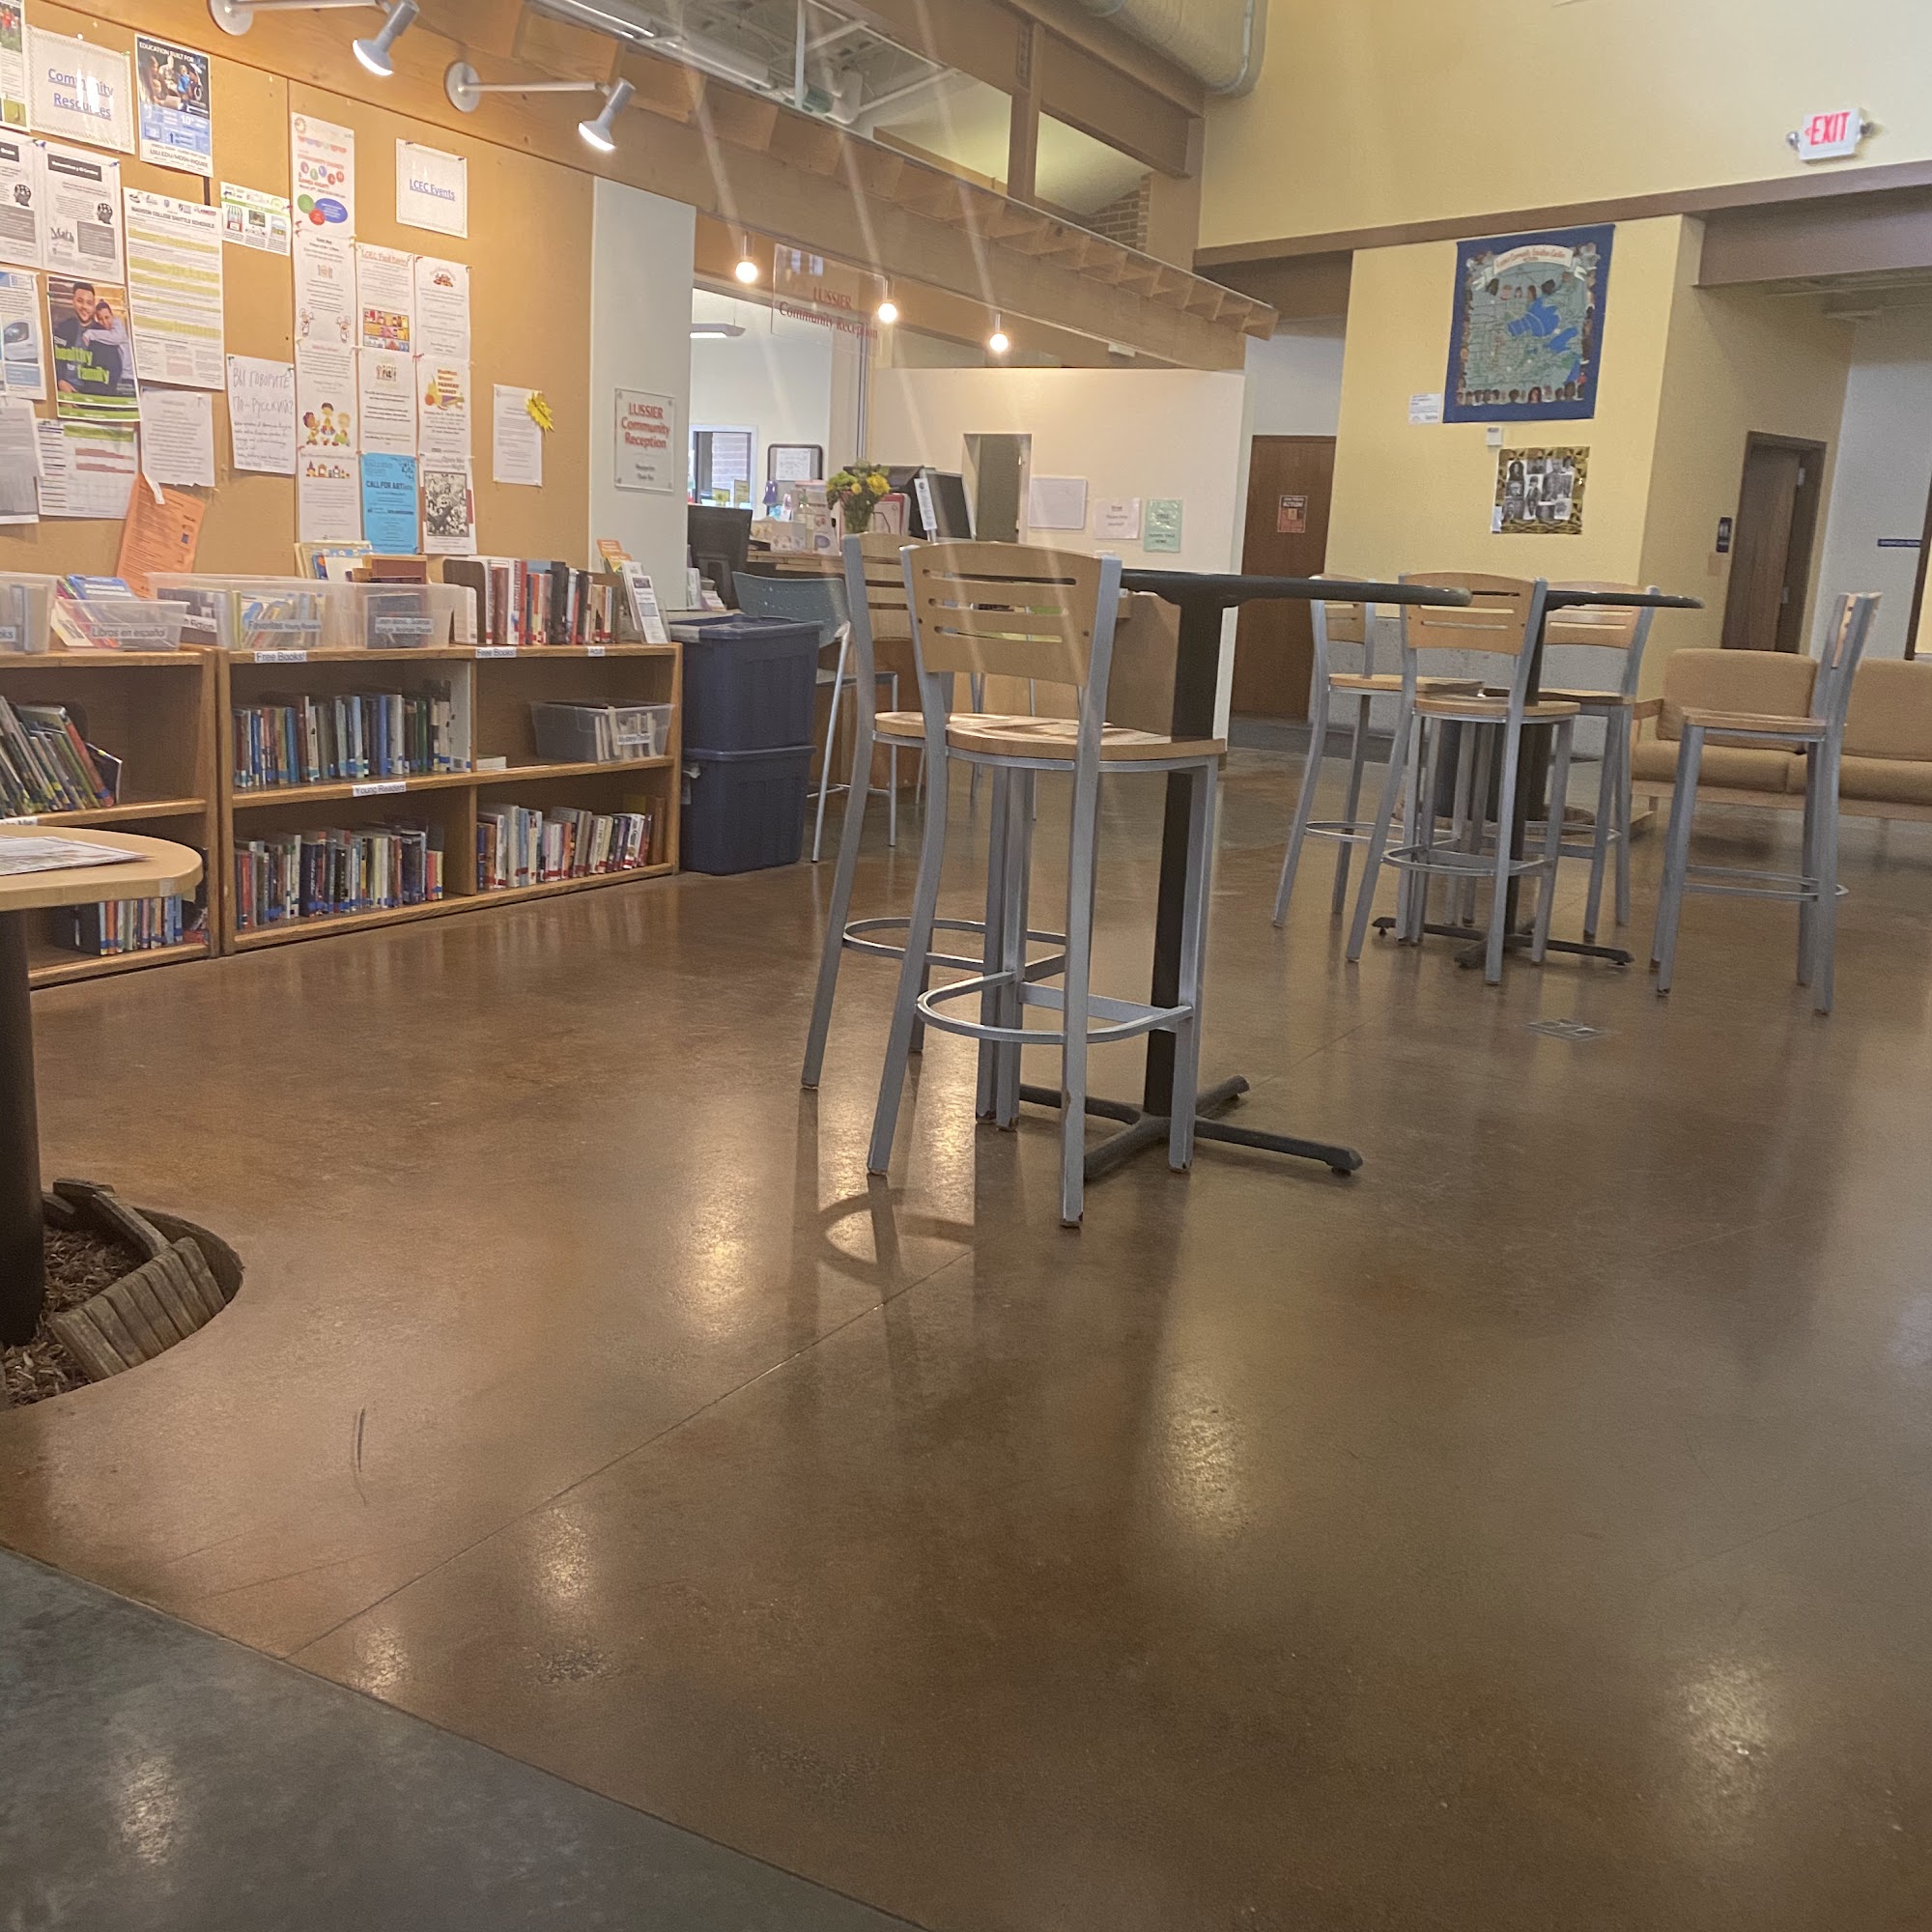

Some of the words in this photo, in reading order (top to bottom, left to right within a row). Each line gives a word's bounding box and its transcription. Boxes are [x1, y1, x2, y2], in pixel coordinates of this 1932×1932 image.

[139, 42, 169, 55] EDUCATION
[48, 68, 114, 96] Commity
[54, 92, 111, 119] Resues
[1810, 111, 1852, 146] EXIT
[410, 179, 429, 192] LCEC
[430, 185, 456, 200] Events
[153, 211, 171, 220] COLLEGE
[813, 286, 852, 310] LUSSIER
[779, 301, 833, 331] Community
[836, 317, 878, 341] Reception
[629, 403, 664, 419] LUSSIER
[621, 416, 670, 439] Community
[625, 432, 668, 450] Reception
[92, 627, 118, 638] Libros
[133, 628, 165, 638] español
[247, 621, 284, 630] Favorites
[256, 652, 276, 662] Free
[277, 651, 305, 662] Books!
[476, 648, 493, 657] Free
